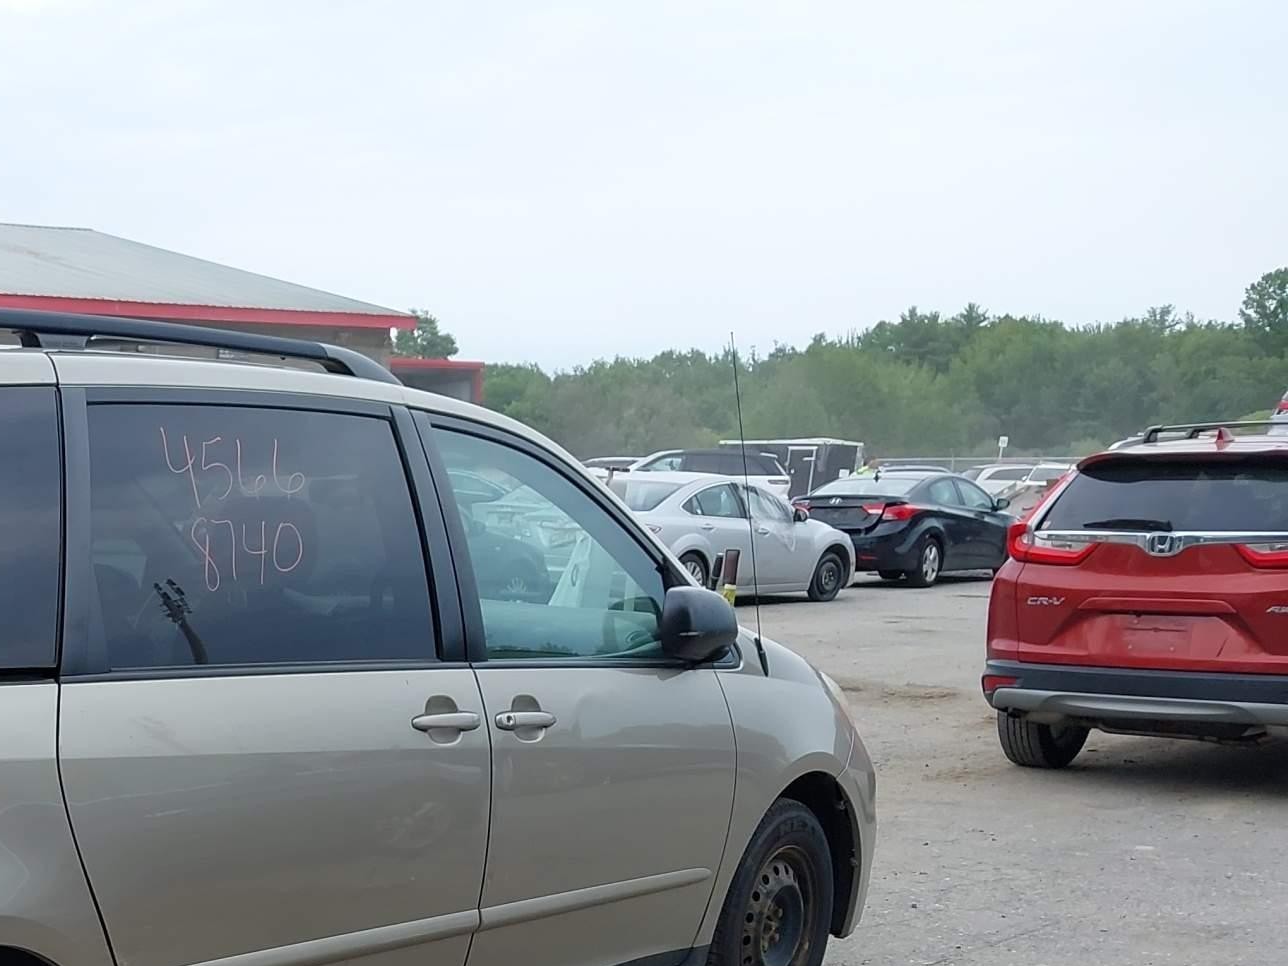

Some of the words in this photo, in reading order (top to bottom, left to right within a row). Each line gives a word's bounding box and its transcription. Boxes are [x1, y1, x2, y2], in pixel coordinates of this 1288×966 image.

[160, 426, 305, 508] 4566
[191, 517, 303, 592] 8740
[1027, 596, 1066, 606] CR-V
